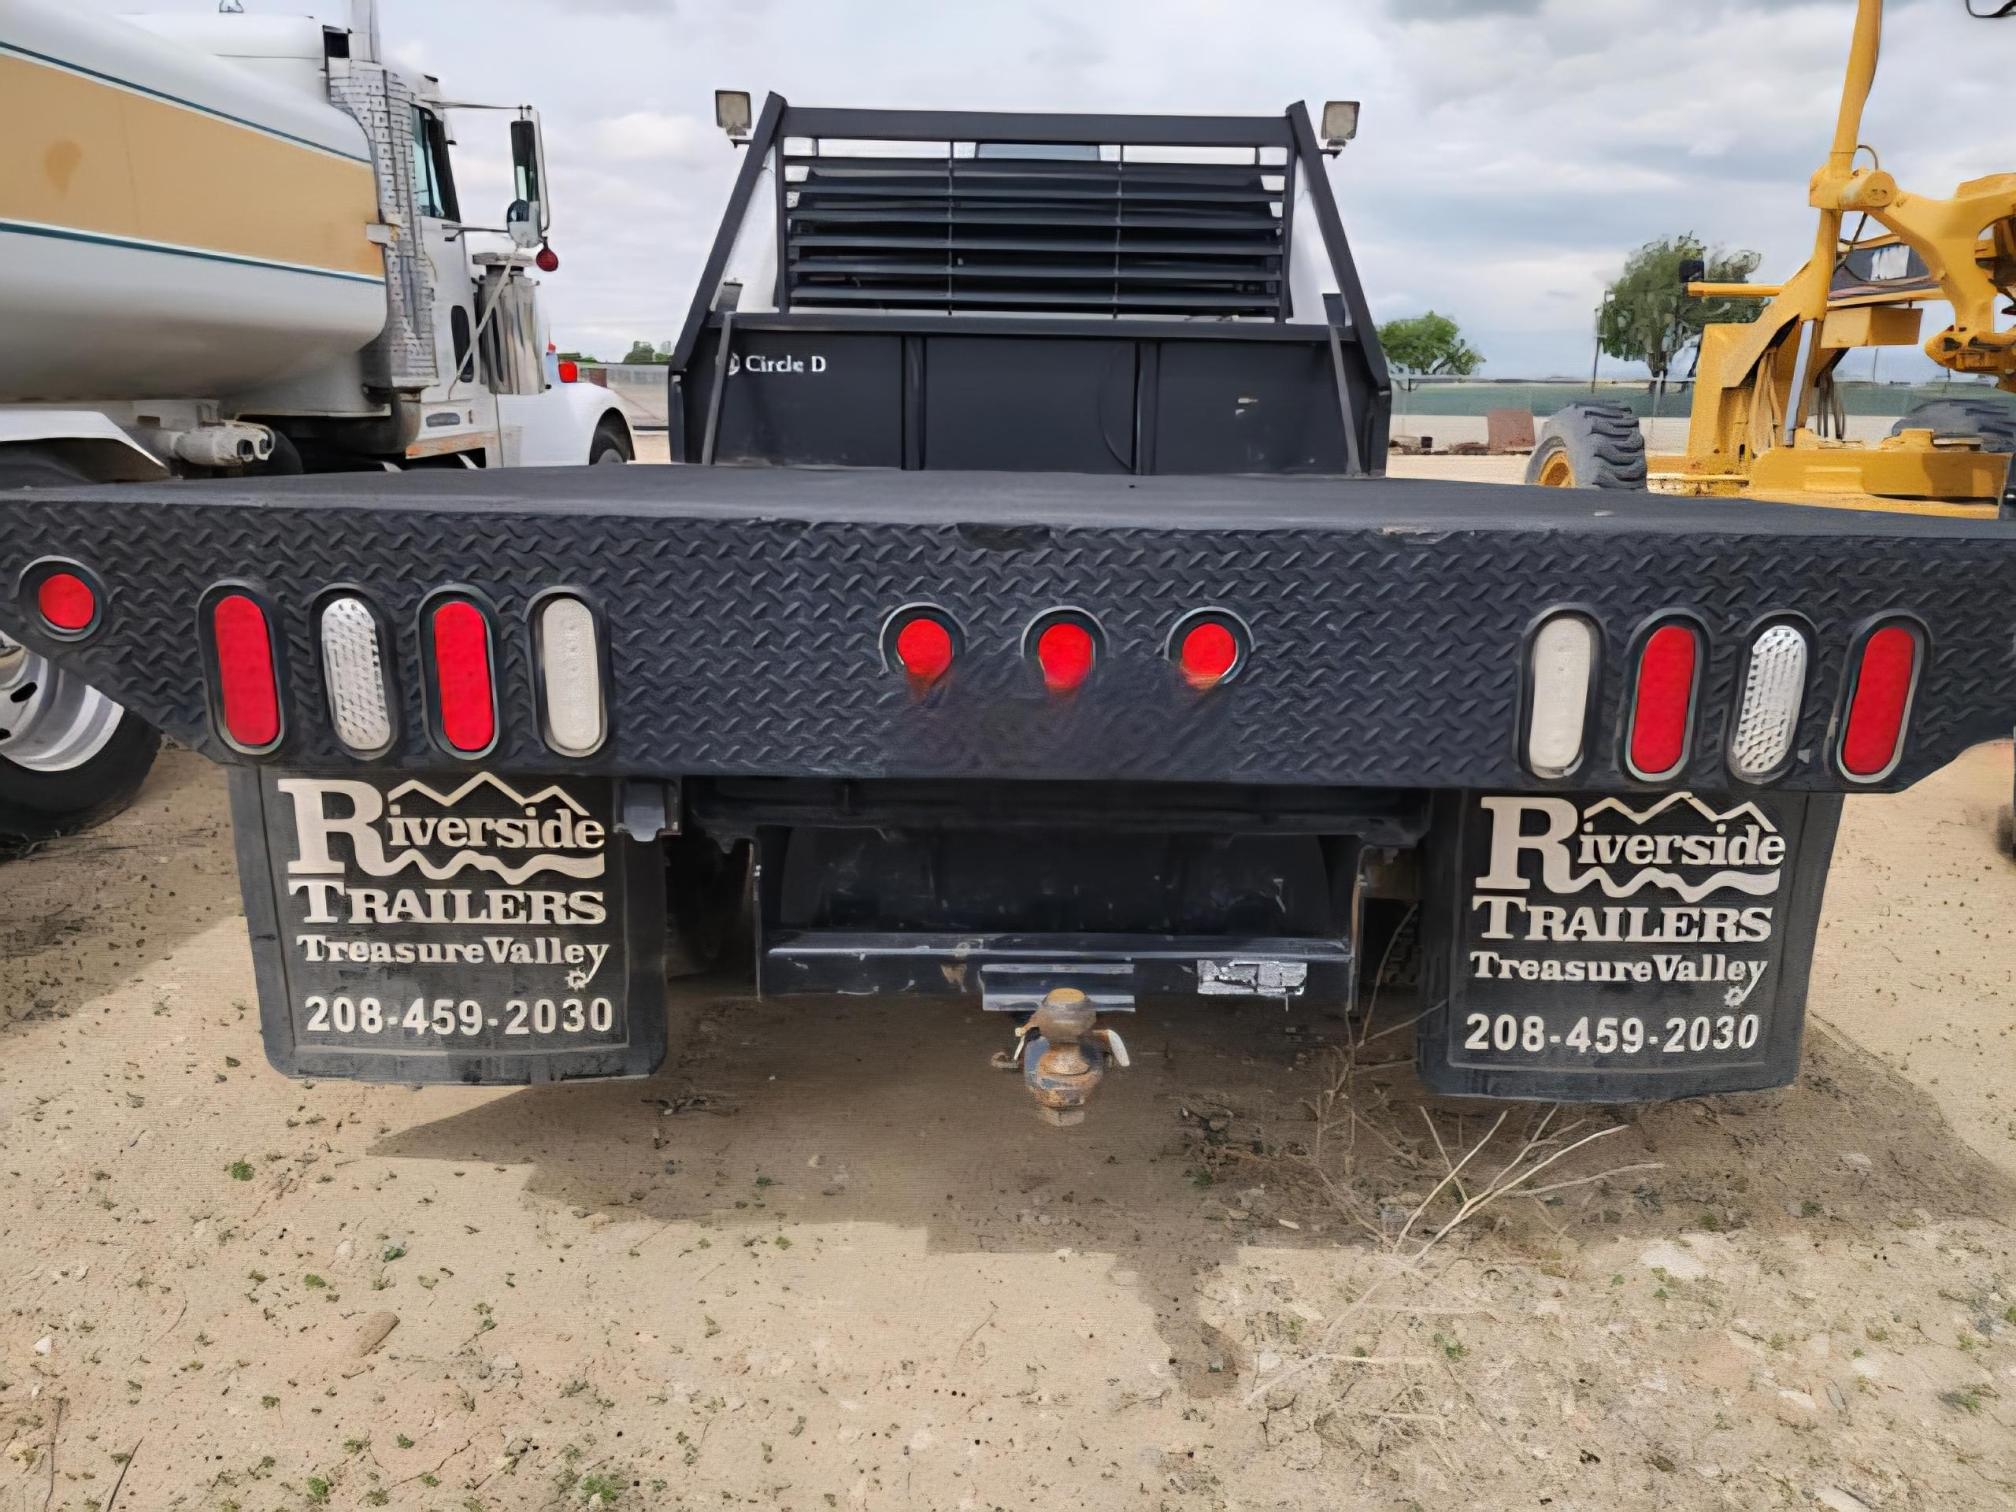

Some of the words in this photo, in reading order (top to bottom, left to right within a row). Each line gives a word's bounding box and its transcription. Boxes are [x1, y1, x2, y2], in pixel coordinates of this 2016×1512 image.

[745, 354, 804, 373] Circle
[811, 355, 827, 373] D
[277, 778, 605, 877] Riverside
[1474, 796, 1786, 894] Riverside
[287, 878, 607, 925] TRAILERS
[1472, 895, 1773, 943] TRAILERS
[304, 996, 613, 1036] 208-459-2030
[1464, 1013, 1760, 1054] 208-459-2030
